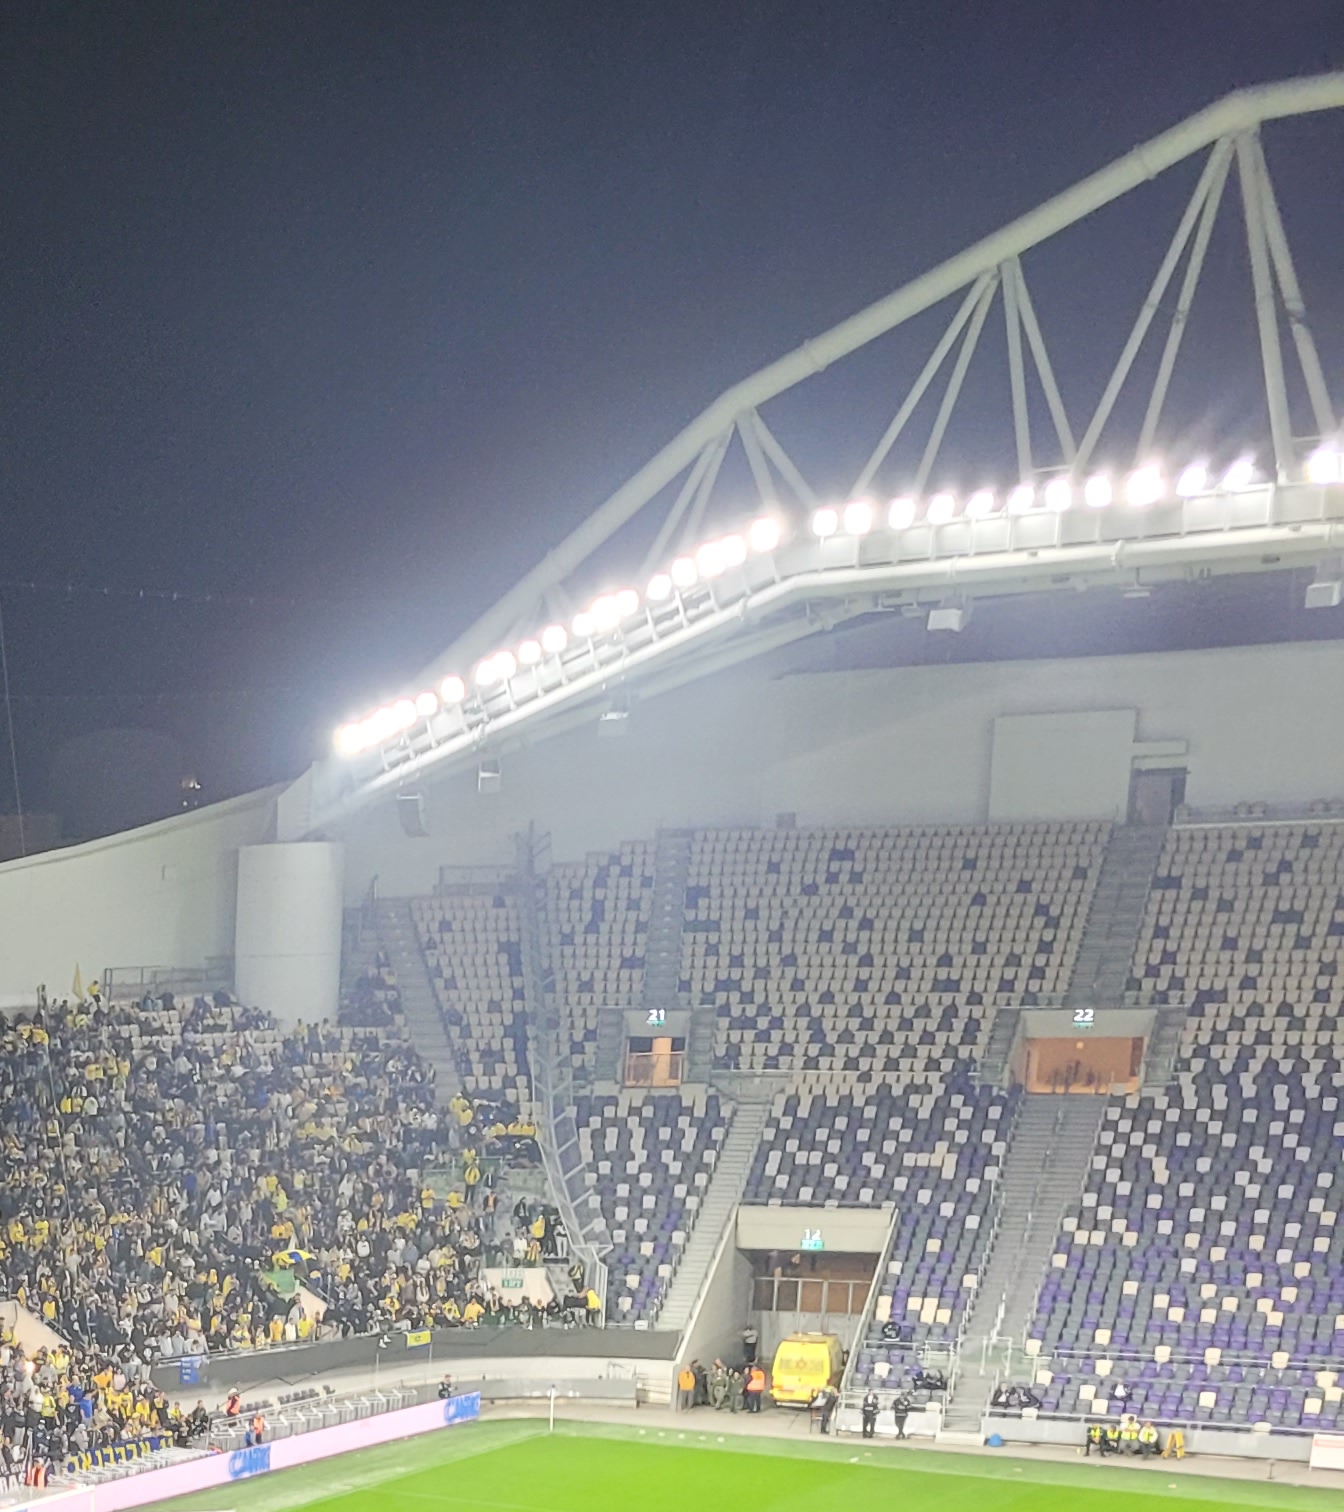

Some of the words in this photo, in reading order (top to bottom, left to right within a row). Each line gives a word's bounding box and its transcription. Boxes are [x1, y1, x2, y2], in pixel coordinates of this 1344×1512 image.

[648, 1009, 665, 1021] 21
[1073, 1008, 1094, 1022] 22
[804, 1228, 821, 1240] 12
